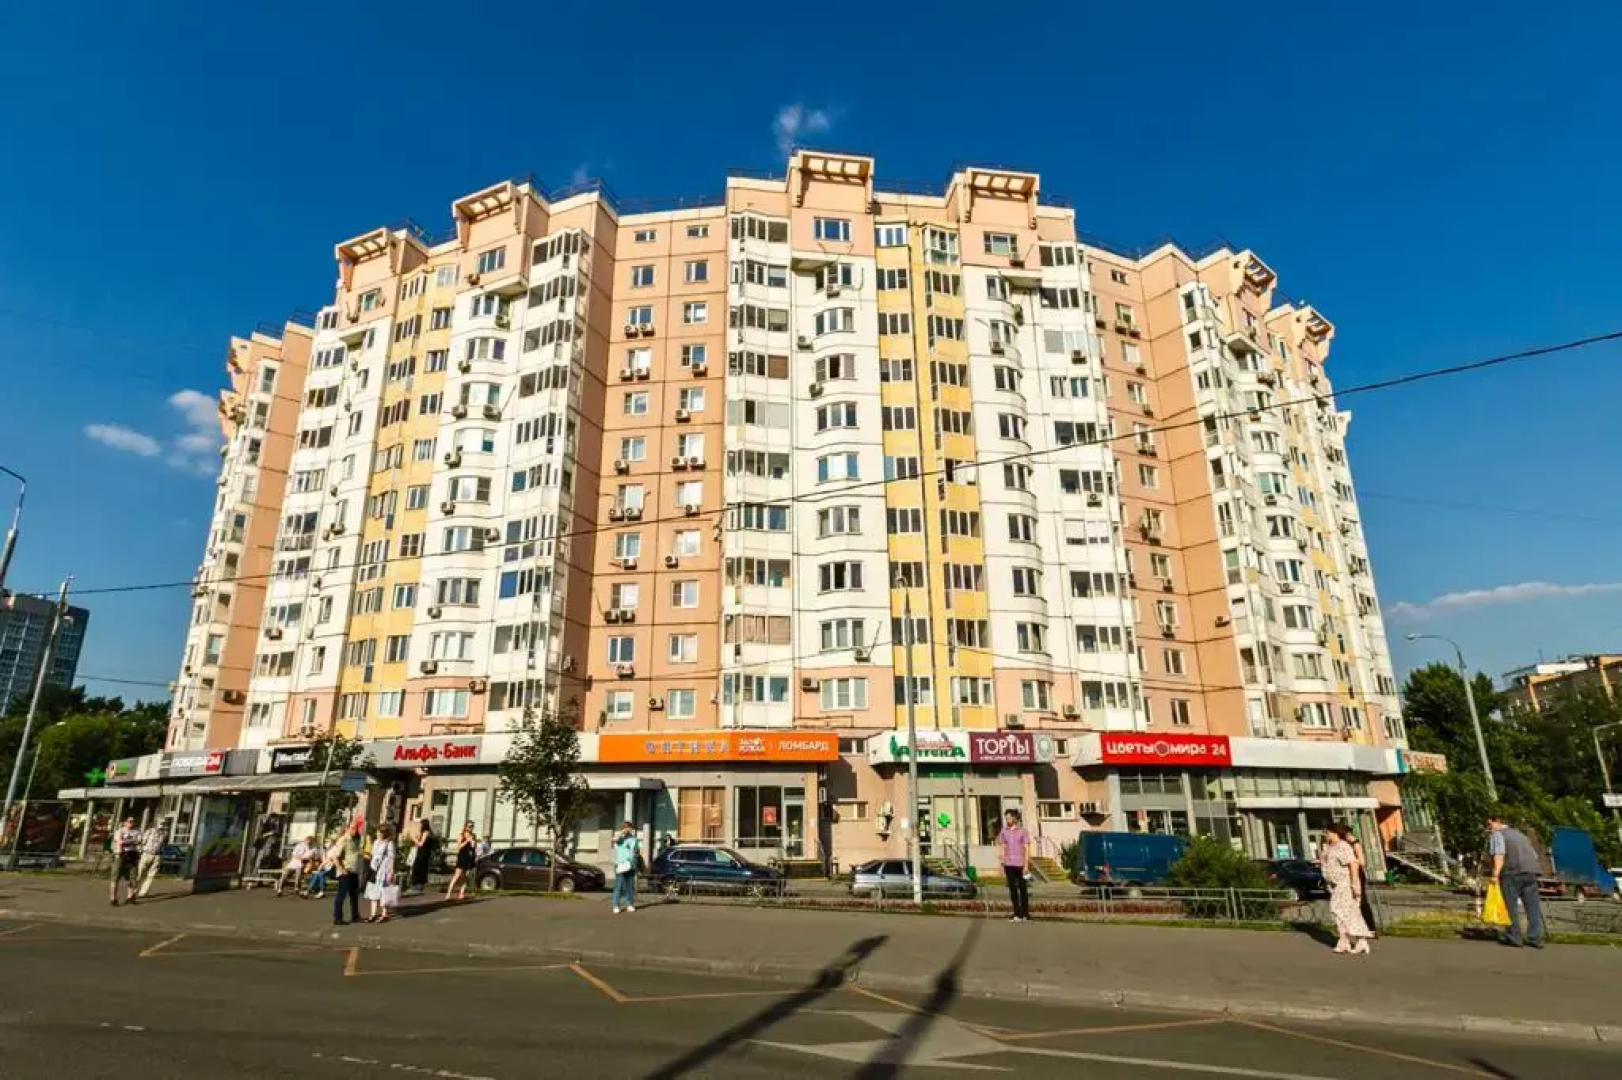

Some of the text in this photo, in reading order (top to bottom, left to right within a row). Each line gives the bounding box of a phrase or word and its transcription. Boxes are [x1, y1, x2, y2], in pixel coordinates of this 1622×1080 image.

[393, 743, 477, 762] Альфа-Банк
[779, 740, 830, 752] ЛОМБАРД
[976, 735, 1030, 755] ТОРТЫ
[1211, 743, 1227, 756] 24
